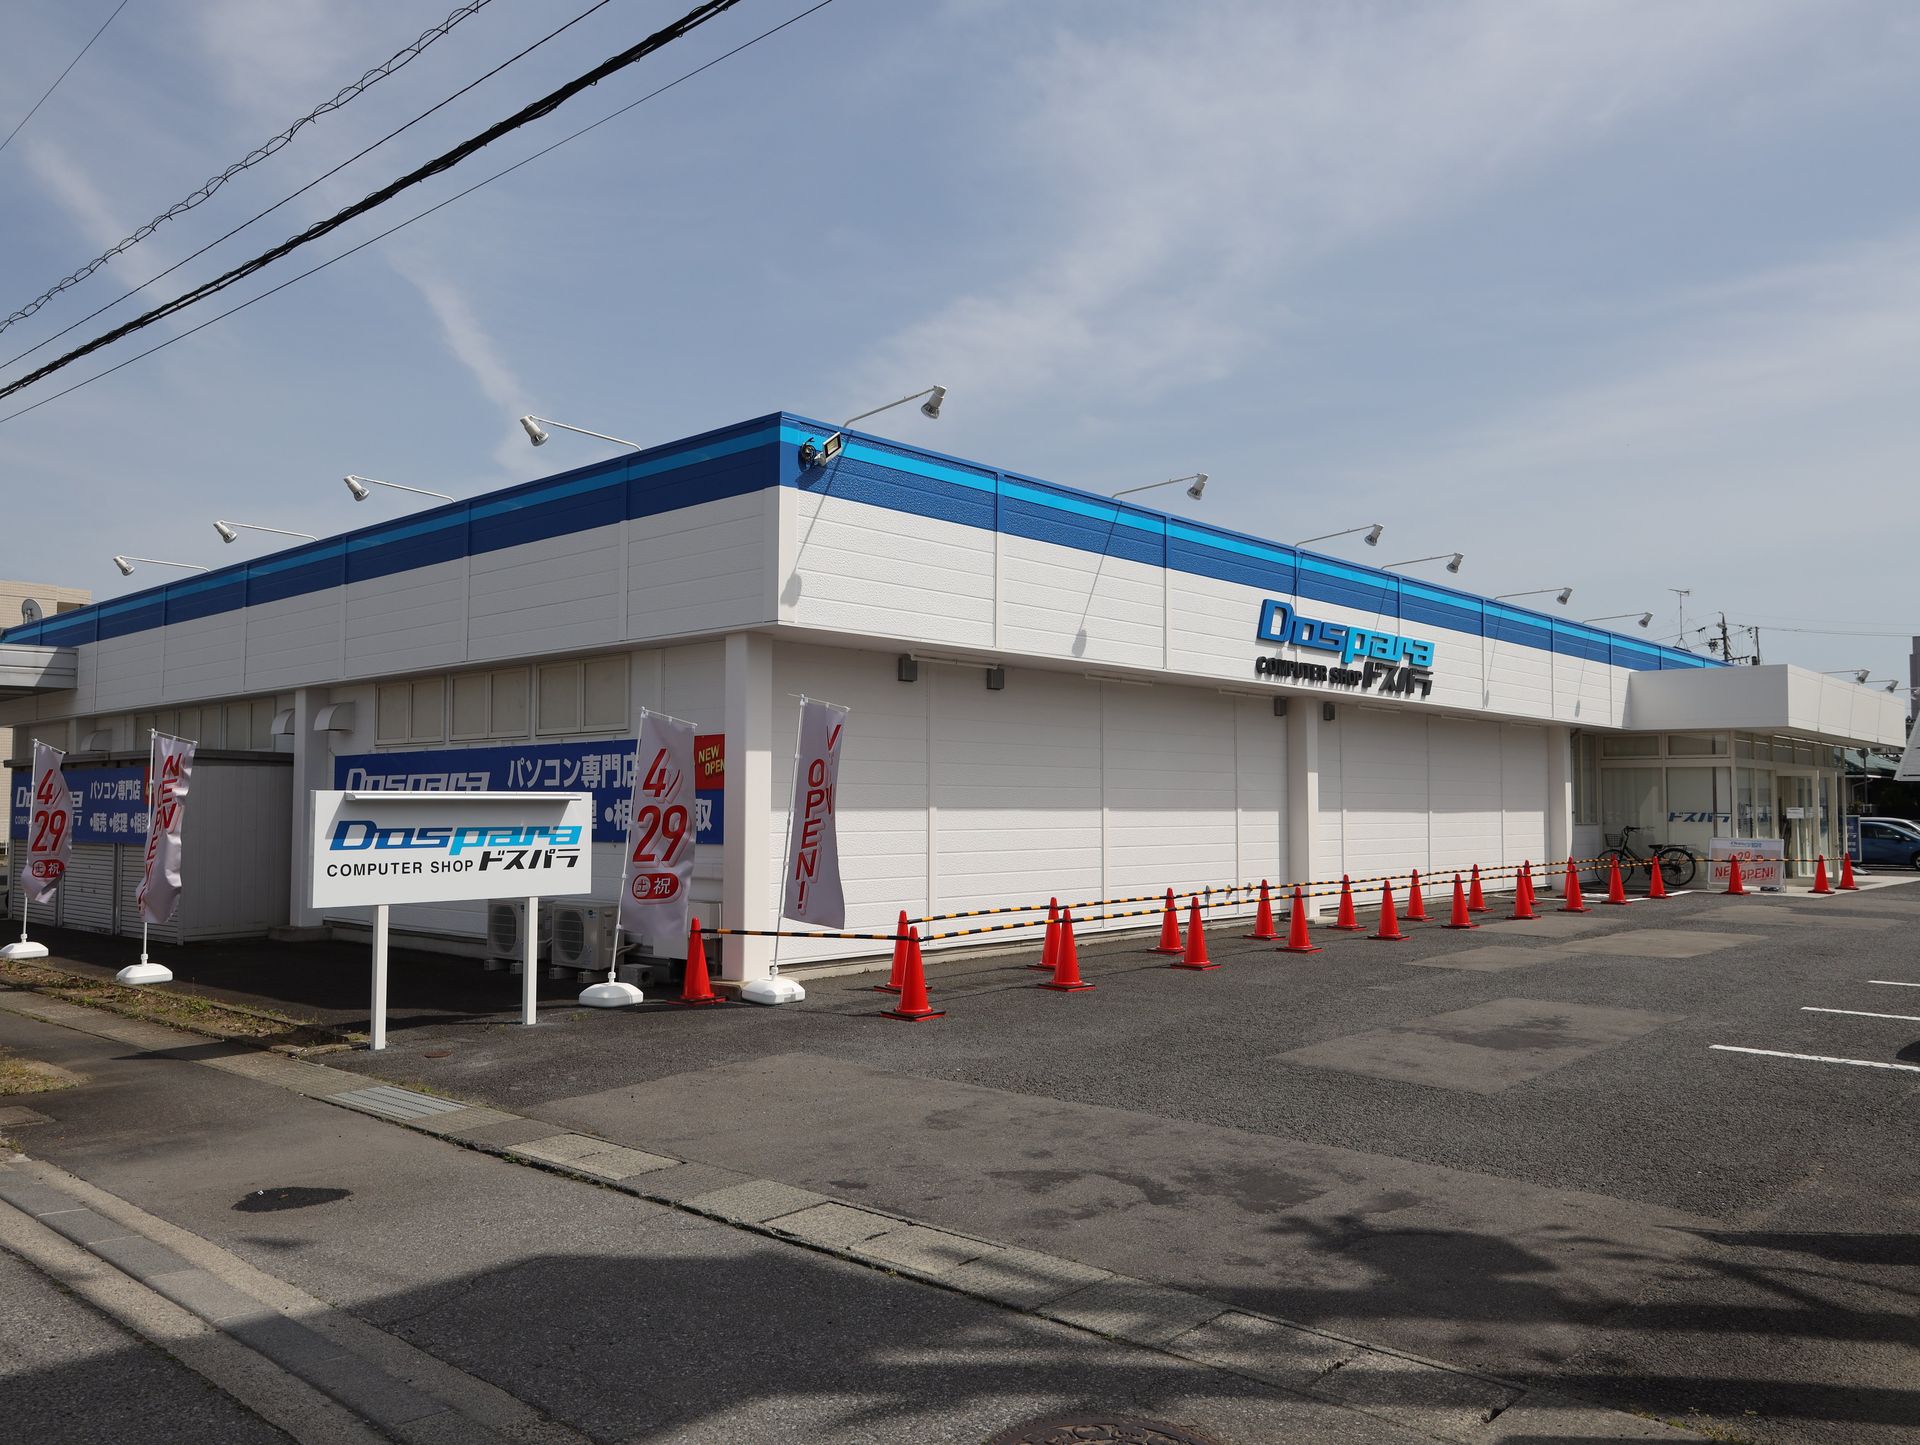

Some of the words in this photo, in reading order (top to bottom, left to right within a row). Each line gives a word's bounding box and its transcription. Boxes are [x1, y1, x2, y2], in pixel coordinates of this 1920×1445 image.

[1257, 599, 1435, 667] Dospara
[1256, 656, 1328, 682] COMPUTER
[1329, 666, 1363, 686] SHOP
[1361, 661, 1434, 696] ドスパラ
[507, 752, 641, 790] パソコン専門店
[698, 744, 720, 764] NEW
[704, 759, 726, 776] OPEN
[90, 779, 141, 800] パソコン専門店
[32, 810, 66, 852] 29
[330, 820, 583, 855] Dospara
[632, 805, 687, 863] 29
[795, 758, 826, 909] OPEN!
[327, 861, 422, 877] COMPUTER
[430, 860, 473, 873] SHOP
[478, 848, 581, 871] ドスパラ
[1715, 866, 1730, 878] NE
